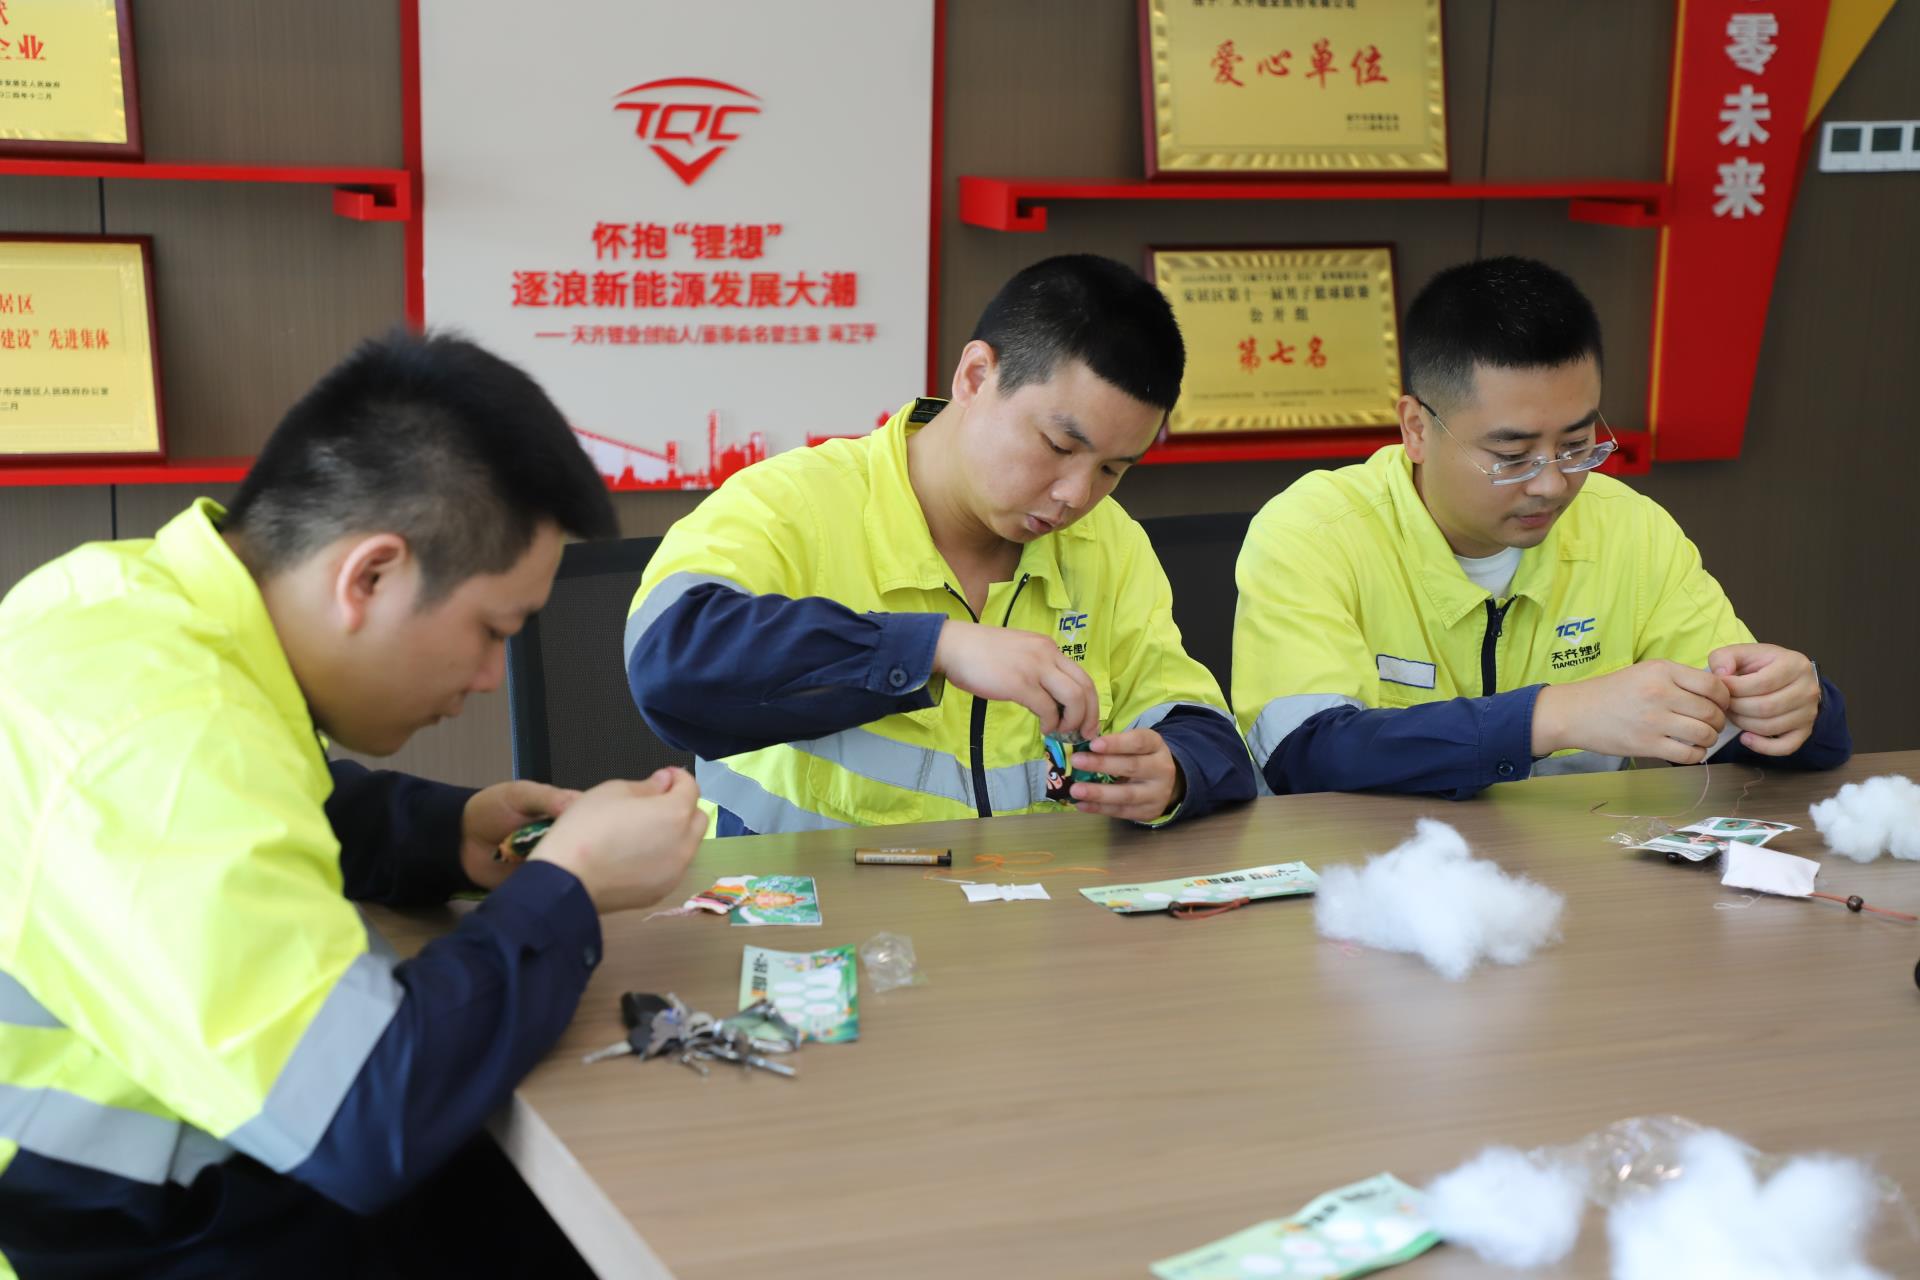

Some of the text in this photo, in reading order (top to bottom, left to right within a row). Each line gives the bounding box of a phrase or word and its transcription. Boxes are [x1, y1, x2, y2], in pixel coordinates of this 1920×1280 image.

[1211, 38, 1389, 90] 爱心单位
[613, 101, 762, 147] TQC
[592, 221, 784, 261] 怀抱“锂想”
[512, 270, 858, 309] 逐浪新能源发展大潮
[1237, 336, 1328, 374] 第七名
[1555, 617, 1596, 638] TQC
